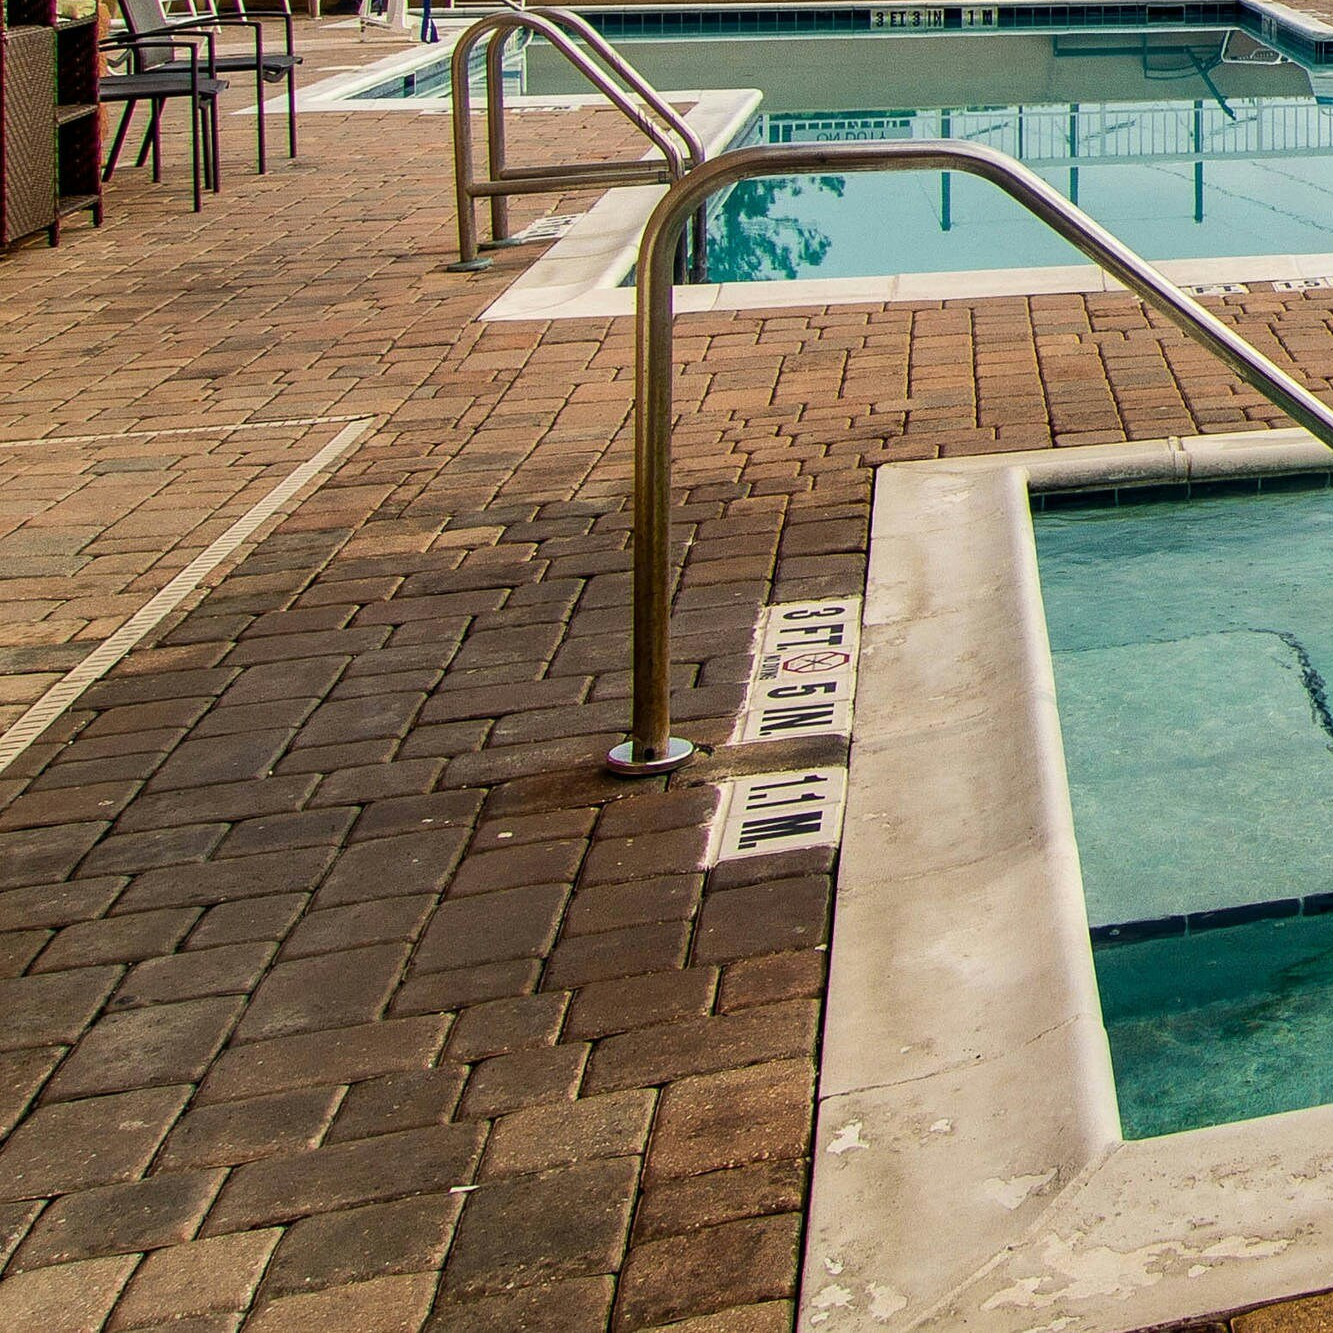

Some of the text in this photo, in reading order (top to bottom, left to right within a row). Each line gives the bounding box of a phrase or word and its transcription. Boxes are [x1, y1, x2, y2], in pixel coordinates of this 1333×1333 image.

[759, 606, 845, 736] 3 FT. 5 IN.
[737, 774, 828, 850] 1.1 M.
